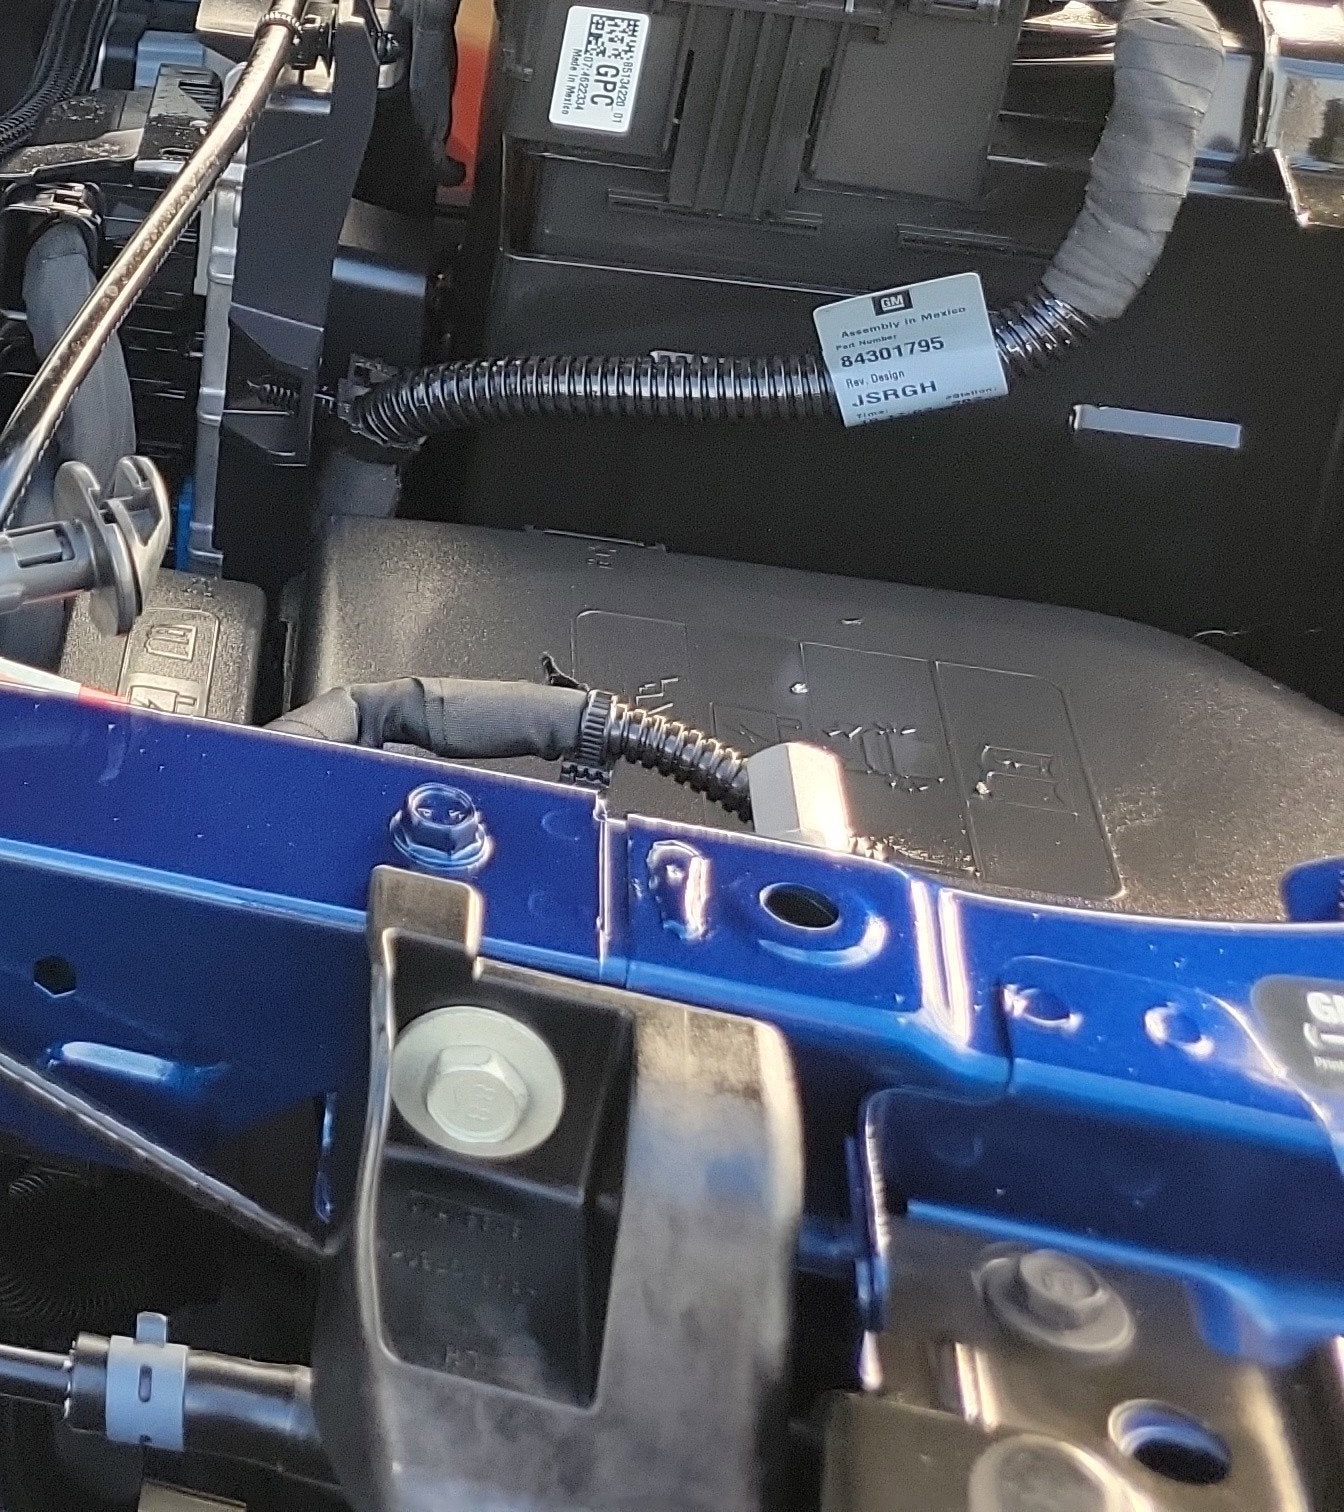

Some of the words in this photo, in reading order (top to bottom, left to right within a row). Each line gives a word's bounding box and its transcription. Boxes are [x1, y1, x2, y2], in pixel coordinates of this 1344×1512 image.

[570, 48, 583, 71] Made
[562, 85, 576, 115] Mexico
[590, 63, 620, 108] GPC
[880, 293, 905, 312] GM
[841, 319, 901, 339] Assembly
[904, 316, 916, 326] in
[921, 306, 966, 322] Mexico
[835, 342, 855, 351] Part
[858, 333, 898, 346] Number
[841, 336, 944, 368] 84301795
[870, 369, 905, 384] Design
[852, 380, 938, 408] JSRGH
[1306, 991, 1344, 1025] G
